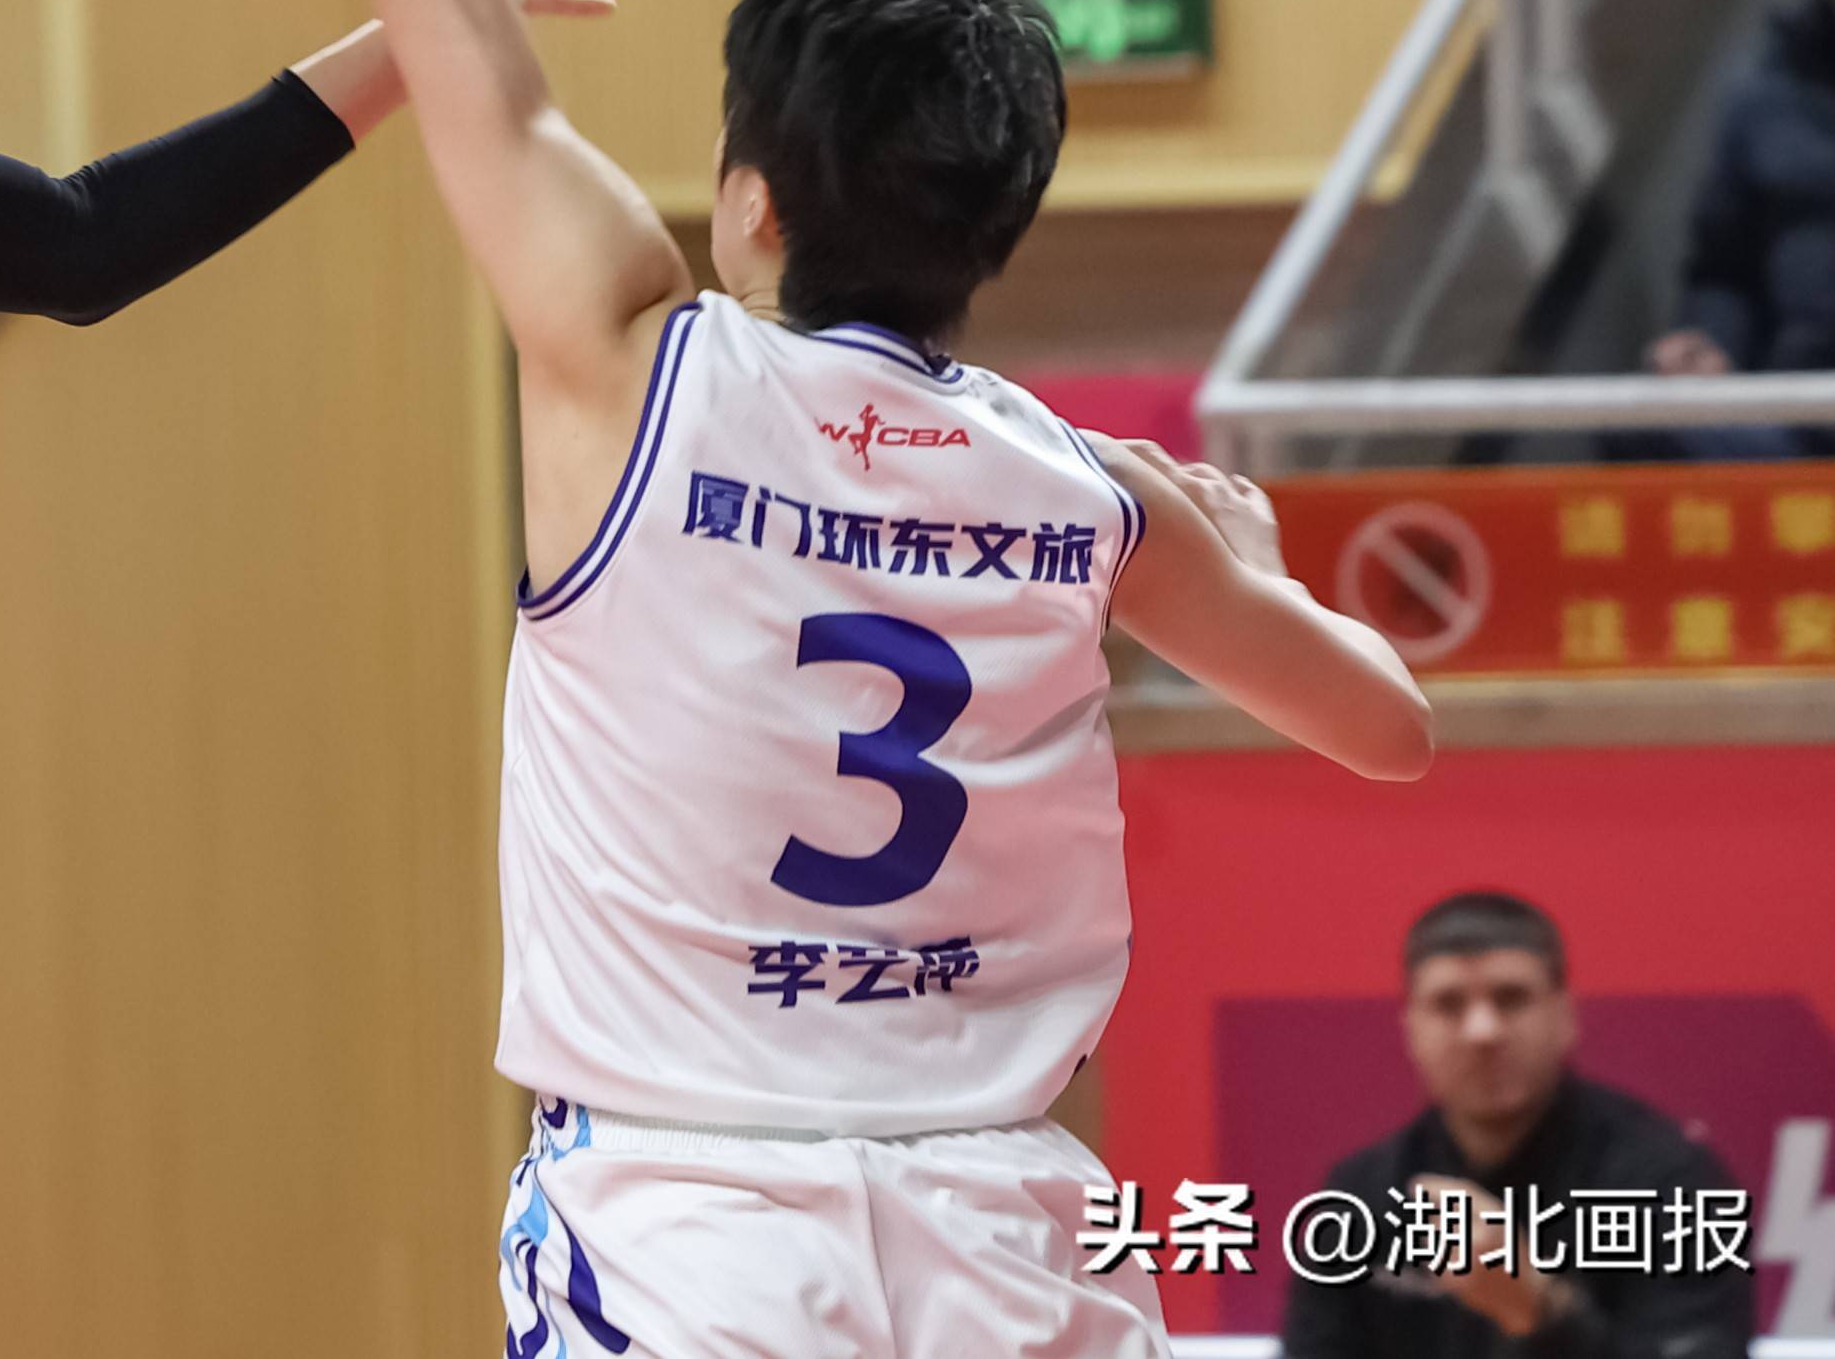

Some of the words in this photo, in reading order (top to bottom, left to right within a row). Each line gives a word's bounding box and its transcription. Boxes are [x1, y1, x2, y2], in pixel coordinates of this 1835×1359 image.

[814, 412, 971, 453] WCBA
[682, 469, 1097, 585] 厦门环东文旅
[770, 611, 973, 909] 3
